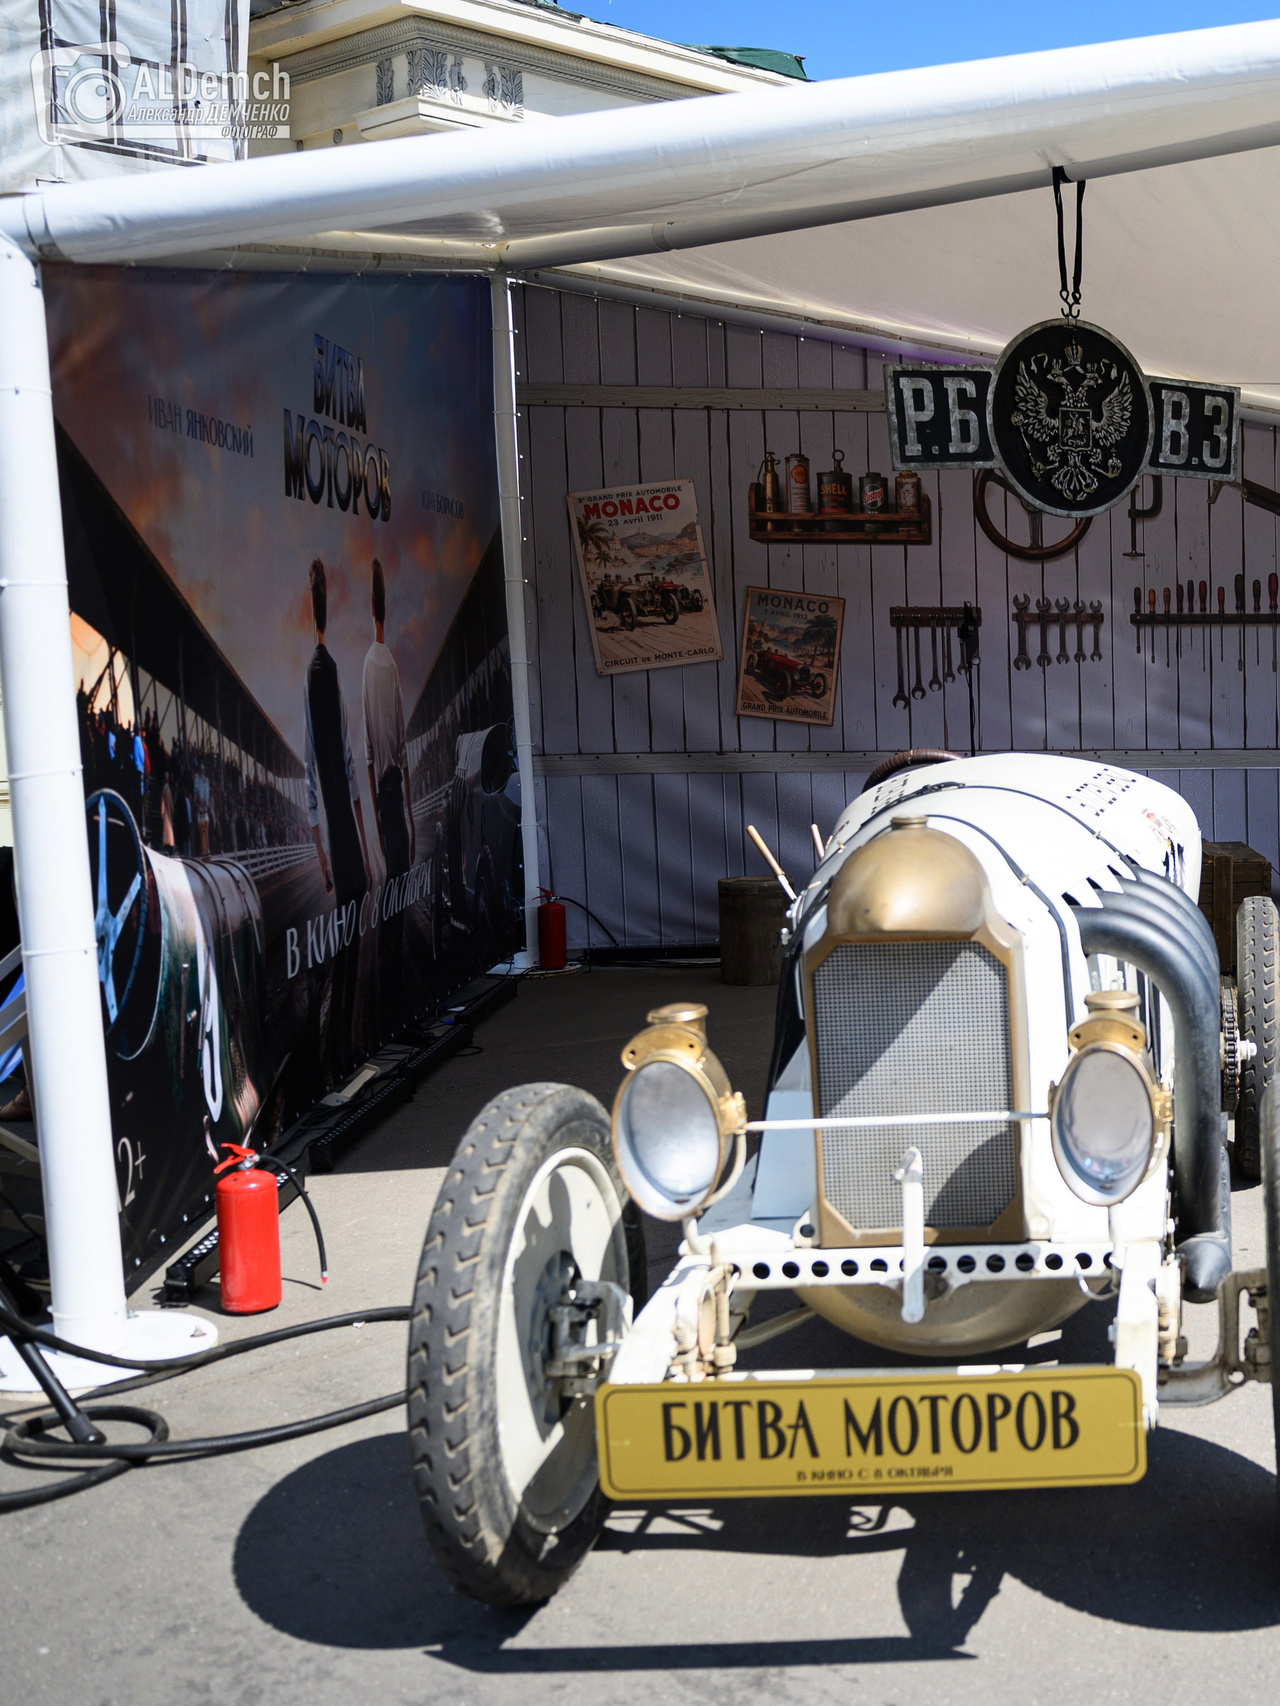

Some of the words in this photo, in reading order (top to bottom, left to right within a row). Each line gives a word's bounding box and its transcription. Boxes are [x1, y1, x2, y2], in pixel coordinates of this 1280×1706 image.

[313, 332, 368, 435] БИТВА
[148, 394, 182, 434] ИВАН
[186, 409, 254, 458] ЯНКОВСКИЙ
[283, 408, 392, 523] МОТОРОВ
[587, 493, 613, 503] GRAND
[616, 491, 633, 499] PRIX
[636, 485, 683, 496] AUTOMOBILE
[820, 483, 847, 495] SHELL
[863, 486, 884, 504] Castrol
[421, 489, 436, 511] ЮРА
[436, 494, 465, 520] БОРИСОВ
[583, 493, 680, 521] MONACO
[607, 519, 619, 527] 23
[647, 513, 663, 522] 1911
[757, 593, 829, 614] MONACO
[771, 610, 791, 618] AVRIL
[793, 612, 808, 620] 1912
[604, 657, 638, 668] CIRCUIT
[654, 647, 715, 661] MONTE-CARLO
[742, 701, 766, 713] GRAND
[768, 704, 784, 713] PRIX
[785, 707, 827, 719] AUTOMOBILE
[286, 927, 300, 980] В
[306, 900, 357, 969] КИНО
[359, 891, 371, 937] С
[371, 885, 382, 929] 8
[382, 858, 433, 921] ОКТЯБРЯ
[117, 1137, 146, 1213] 2+
[661, 1398, 820, 1462] БИТВА
[843, 1390, 1081, 1458] МОТОРОВ
[796, 1470, 807, 1482] В
[811, 1469, 853, 1482] КИНО
[858, 1468, 868, 1480] С
[887, 1466, 953, 1479] ОКТЯБРЯ
